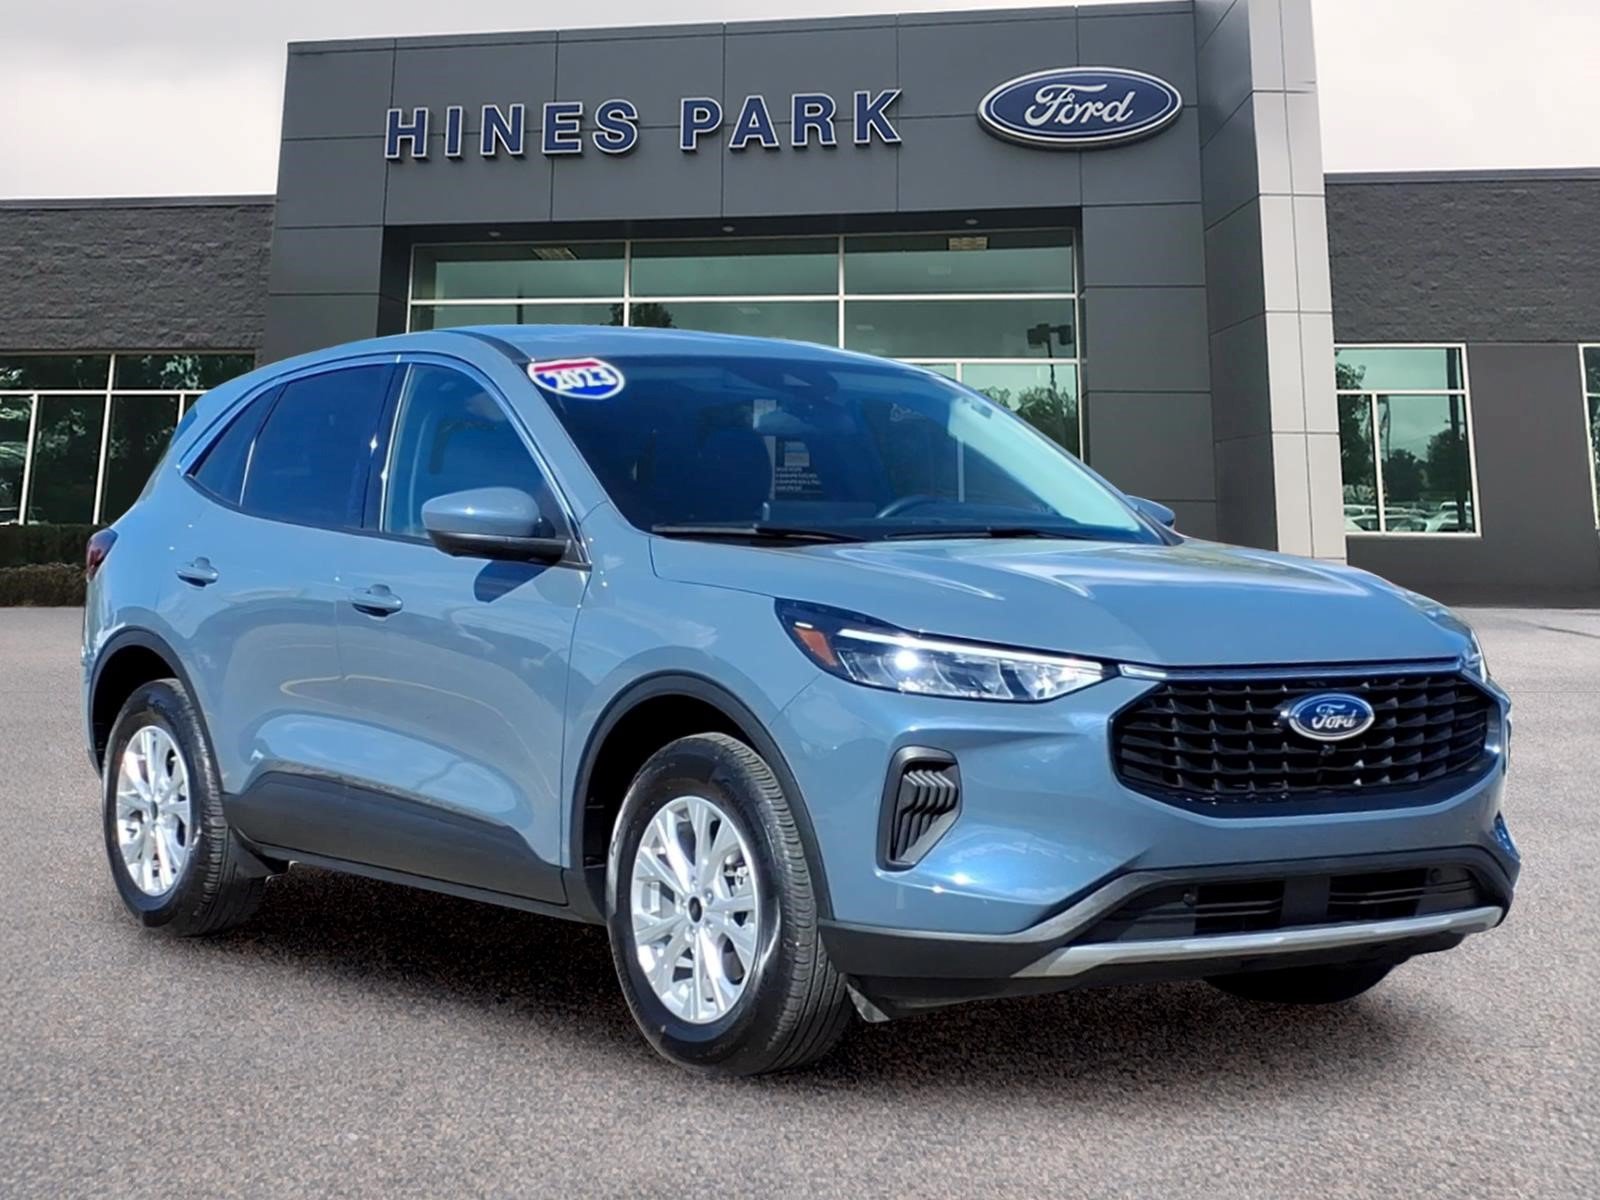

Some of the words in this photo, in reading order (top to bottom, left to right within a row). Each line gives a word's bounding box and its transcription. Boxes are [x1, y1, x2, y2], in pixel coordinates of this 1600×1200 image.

[1024, 84, 1136, 126] Ford
[384, 99, 638, 158] HINES
[680, 89, 902, 151] PARK
[546, 368, 617, 390] 2023
[1311, 703, 1358, 729] Ford
